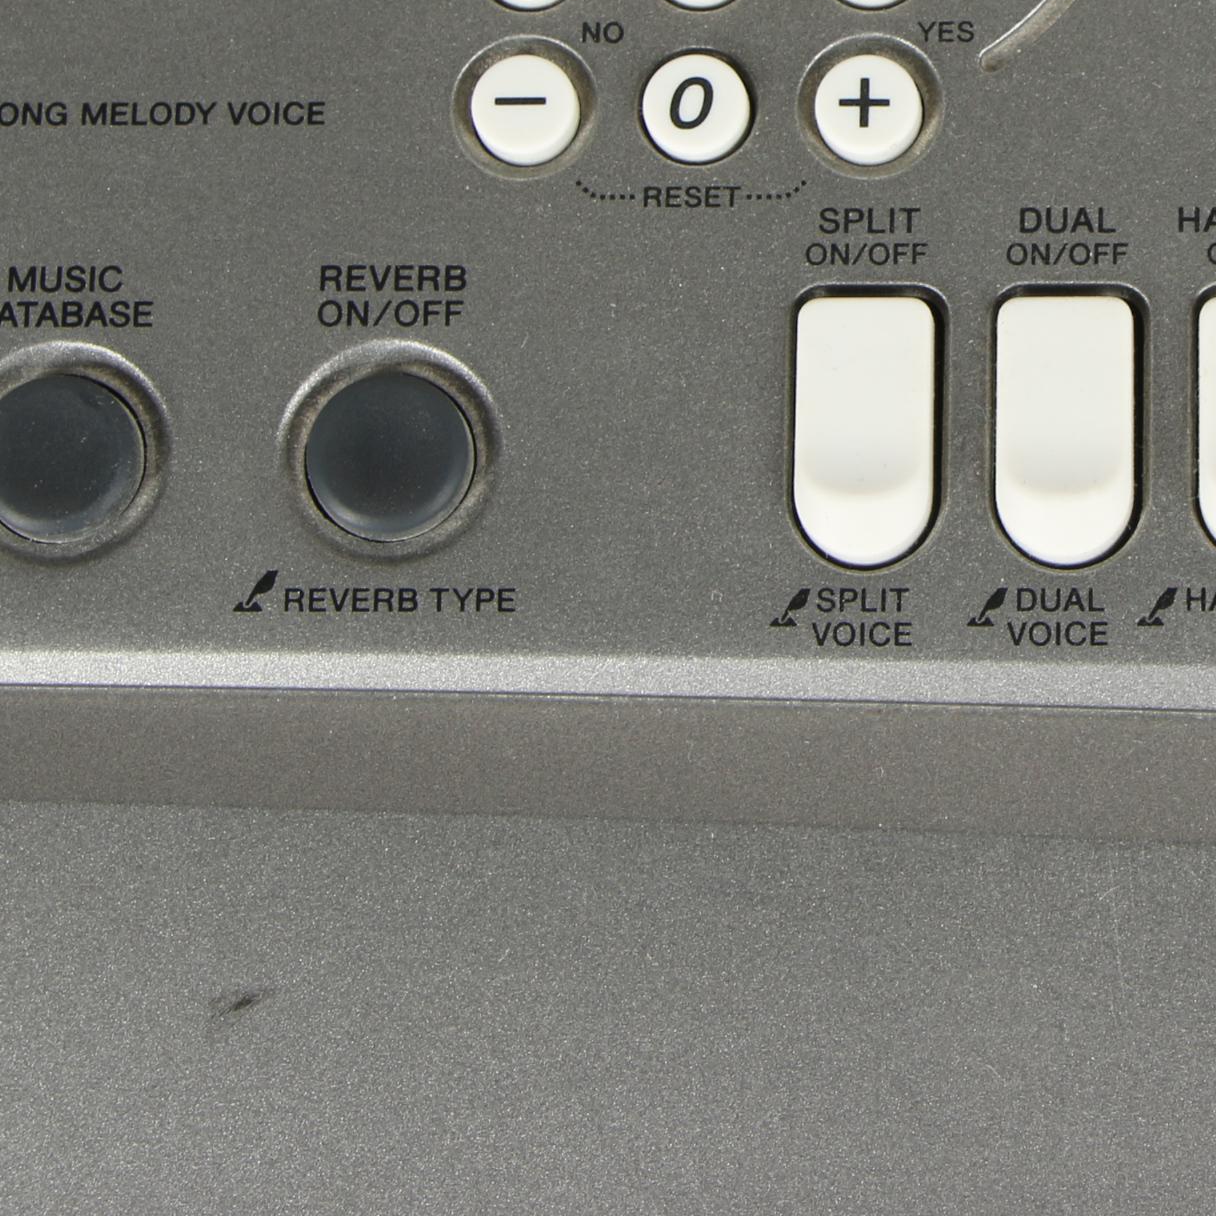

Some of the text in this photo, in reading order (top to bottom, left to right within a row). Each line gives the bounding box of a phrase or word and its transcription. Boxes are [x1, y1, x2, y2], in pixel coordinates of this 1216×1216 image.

[581, 21, 625, 45] NO
[917, 20, 975, 44] YES
[0, 100, 326, 127] ONG MELODY VOICE
[669, 76, 714, 130] 0
[643, 185, 742, 209] RESET
[818, 206, 921, 235] SPLIT
[1019, 206, 1117, 235] DUAL
[804, 242, 929, 267] ON/OFF
[1006, 242, 1129, 266] ON/OFF
[7, 264, 123, 294] MUSIC
[319, 264, 467, 292] REVERB
[317, 299, 465, 328] ON/OFF
[284, 587, 516, 613] REVERB TYPE
[816, 586, 910, 614] SPLIT
[1016, 587, 1105, 613] DUAL
[811, 621, 913, 648] VOICE
[1006, 620, 1109, 647] VOICE
